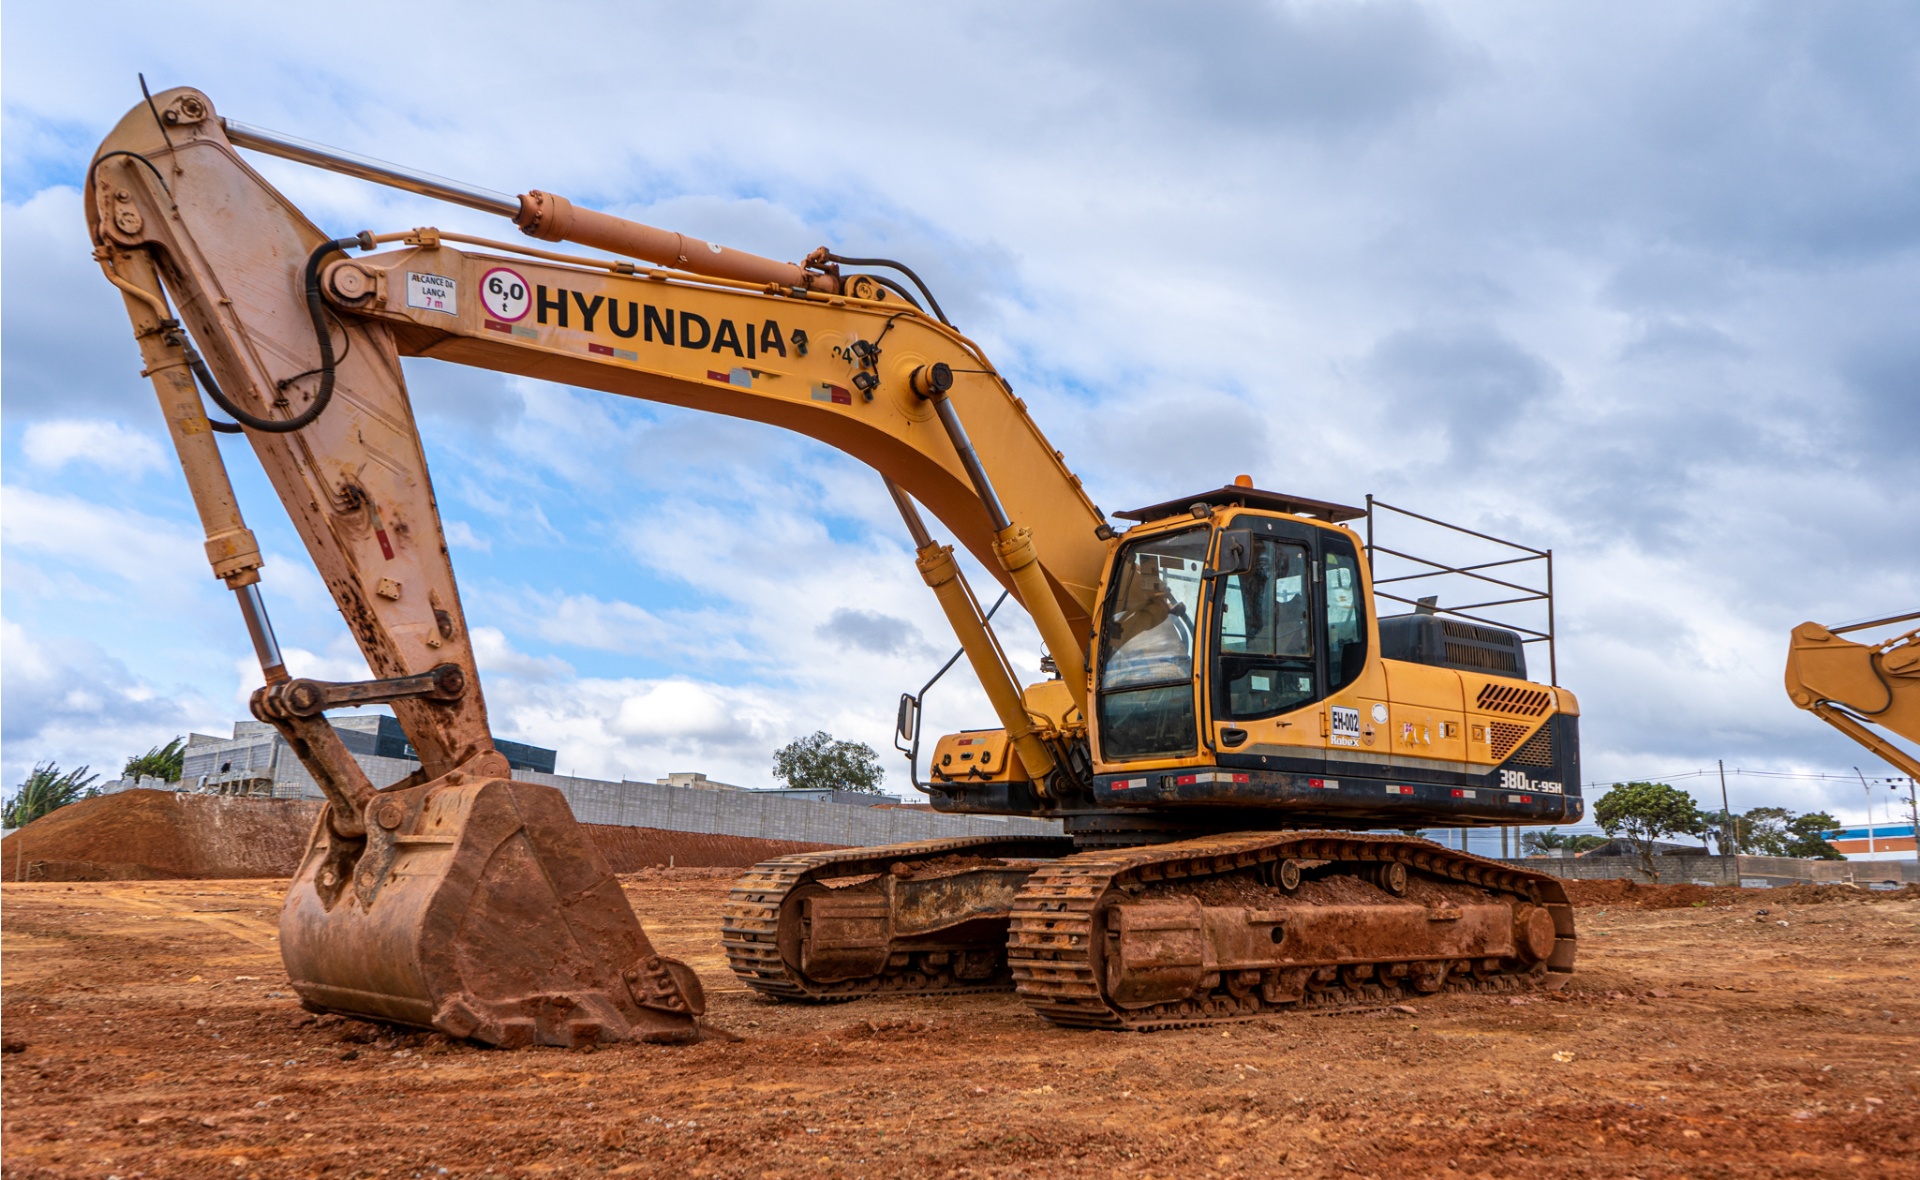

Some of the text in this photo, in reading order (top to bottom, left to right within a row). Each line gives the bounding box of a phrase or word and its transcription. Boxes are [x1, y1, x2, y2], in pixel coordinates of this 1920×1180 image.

[411, 274, 454, 289] ALCANCE DA
[422, 287, 446, 299] LANÇA
[488, 277, 524, 301] 6,0
[426, 296, 443, 309] 7 m
[502, 303, 508, 312] t
[1332, 711, 1359, 732] EH-002
